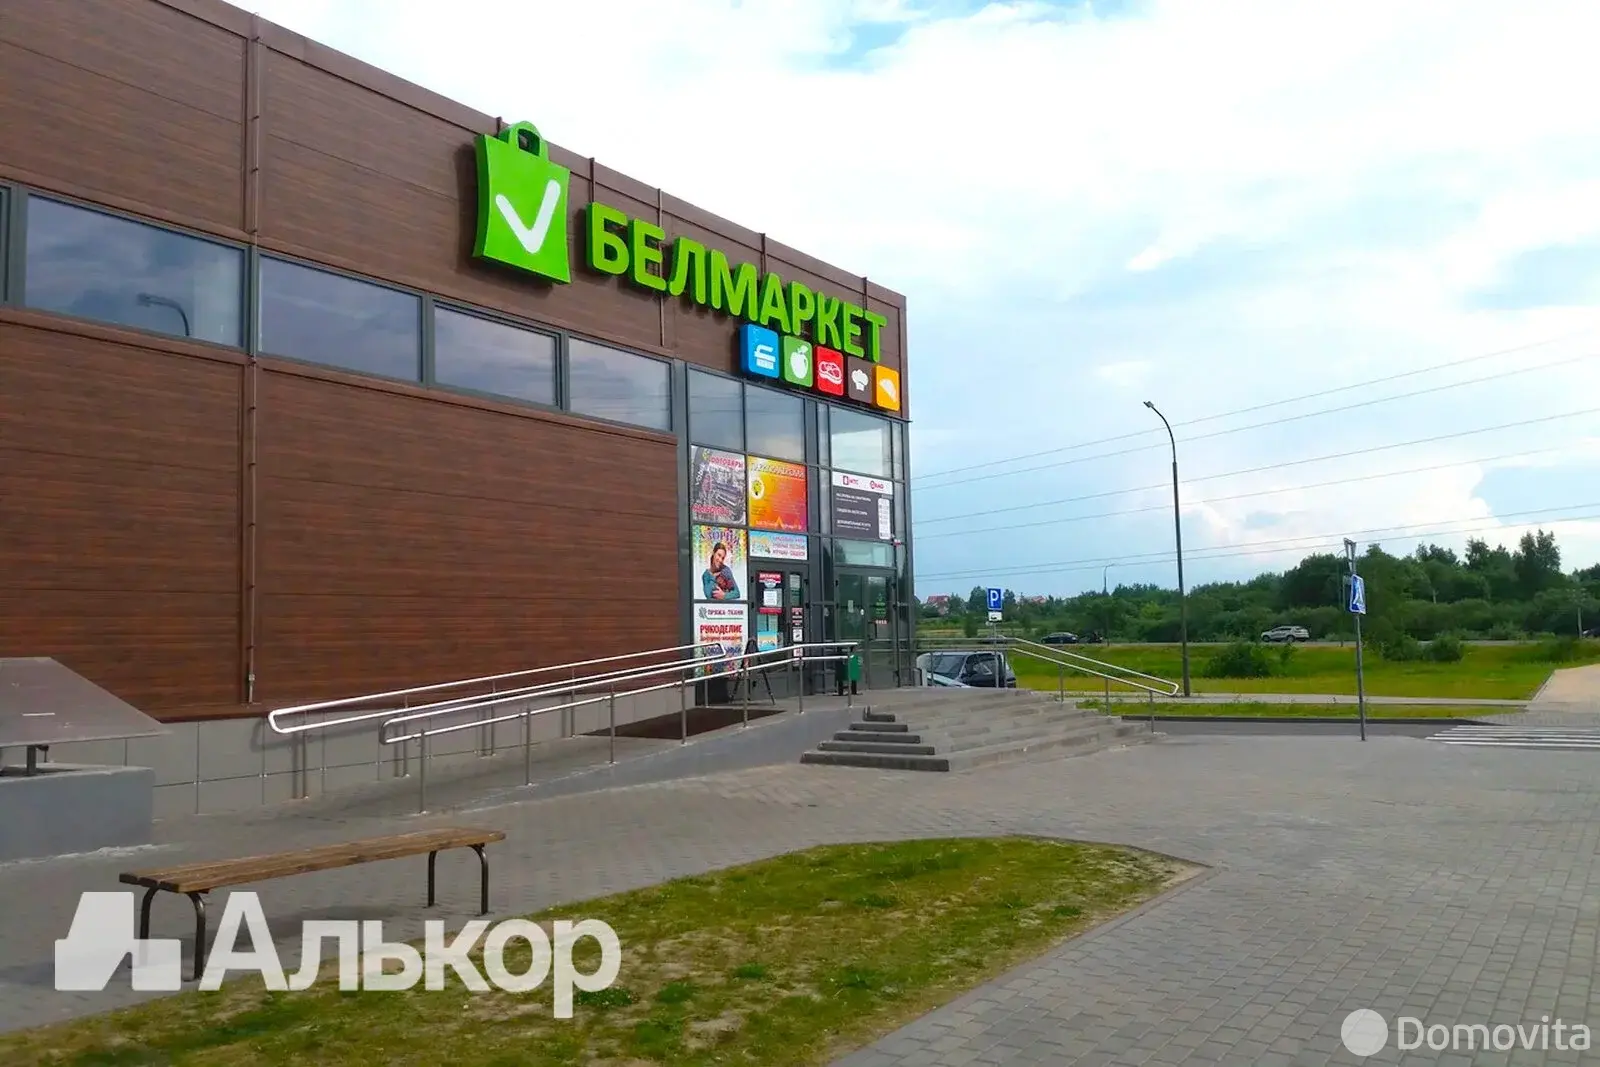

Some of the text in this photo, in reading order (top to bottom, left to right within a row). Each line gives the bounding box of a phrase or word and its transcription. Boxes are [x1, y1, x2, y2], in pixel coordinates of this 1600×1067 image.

[586, 201, 887, 363] БЕЛМАРКЕТ
[990, 590, 999, 607] P
[700, 624, 743, 635] РУКОДЕЛИЕ
